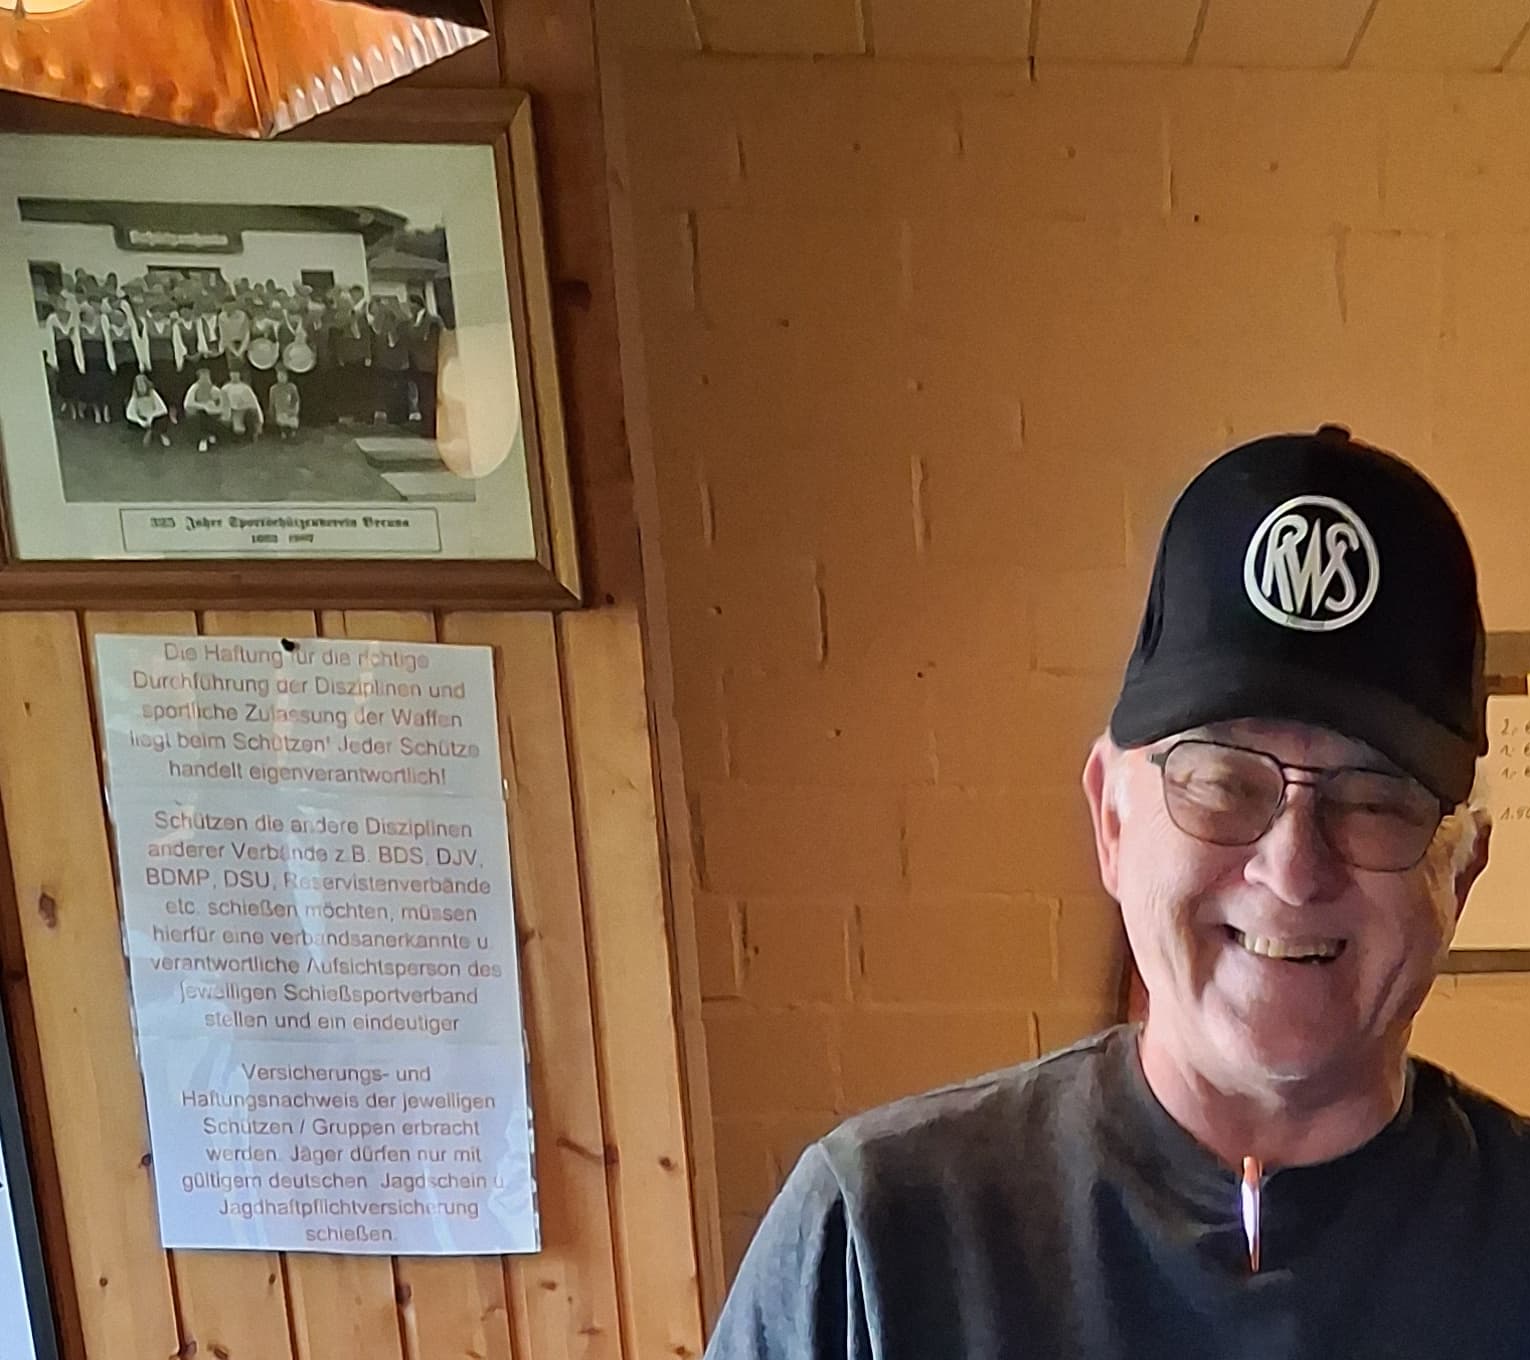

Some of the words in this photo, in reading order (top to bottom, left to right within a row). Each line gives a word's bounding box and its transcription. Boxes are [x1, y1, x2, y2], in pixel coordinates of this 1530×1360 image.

[1260, 513, 1361, 618] RWS
[164, 643, 197, 661] Die
[205, 644, 282, 668] Haftung
[293, 649, 315, 666] ür
[322, 649, 350, 666] die
[133, 671, 269, 697] Durchführung
[429, 682, 465, 699] und
[355, 708, 384, 725] der
[392, 709, 463, 727] Waffen
[177, 733, 226, 749] beim
[338, 737, 392, 755] Jeder
[168, 761, 243, 778] handelt
[154, 810, 249, 832] Schützen
[255, 814, 284, 832] die
[290, 817, 359, 834] andere
[366, 817, 473, 840] Disziplinen
[148, 841, 225, 858] anderer
[153, 926, 216, 944] hierfür
[223, 931, 264, 944] eine
[151, 956, 299, 974] verantwortliche
[307, 958, 461, 980] Aufsichtsperson
[467, 962, 503, 977] des
[283, 984, 479, 1007] Schießsportverband
[205, 1011, 268, 1028] stellen
[275, 1012, 310, 1029] und
[317, 1015, 346, 1029] ein
[353, 1014, 459, 1035] eindeutiger
[241, 1063, 389, 1086] Versicherungs-
[396, 1066, 431, 1081] und
[182, 1091, 360, 1112] Haftungsnachweis
[365, 1092, 396, 1108] der
[402, 1092, 496, 1113] jeweiligen
[202, 1117, 293, 1135] Schützen
[312, 1119, 396, 1139] Gruppen
[402, 1119, 480, 1136] erbracht
[290, 1146, 343, 1166] Jäger
[350, 1145, 410, 1162] dürfen
[416, 1148, 446, 1162] nur
[453, 1147, 481, 1162] mit
[182, 1171, 261, 1193] gültigem
[268, 1172, 368, 1189] deutschen
